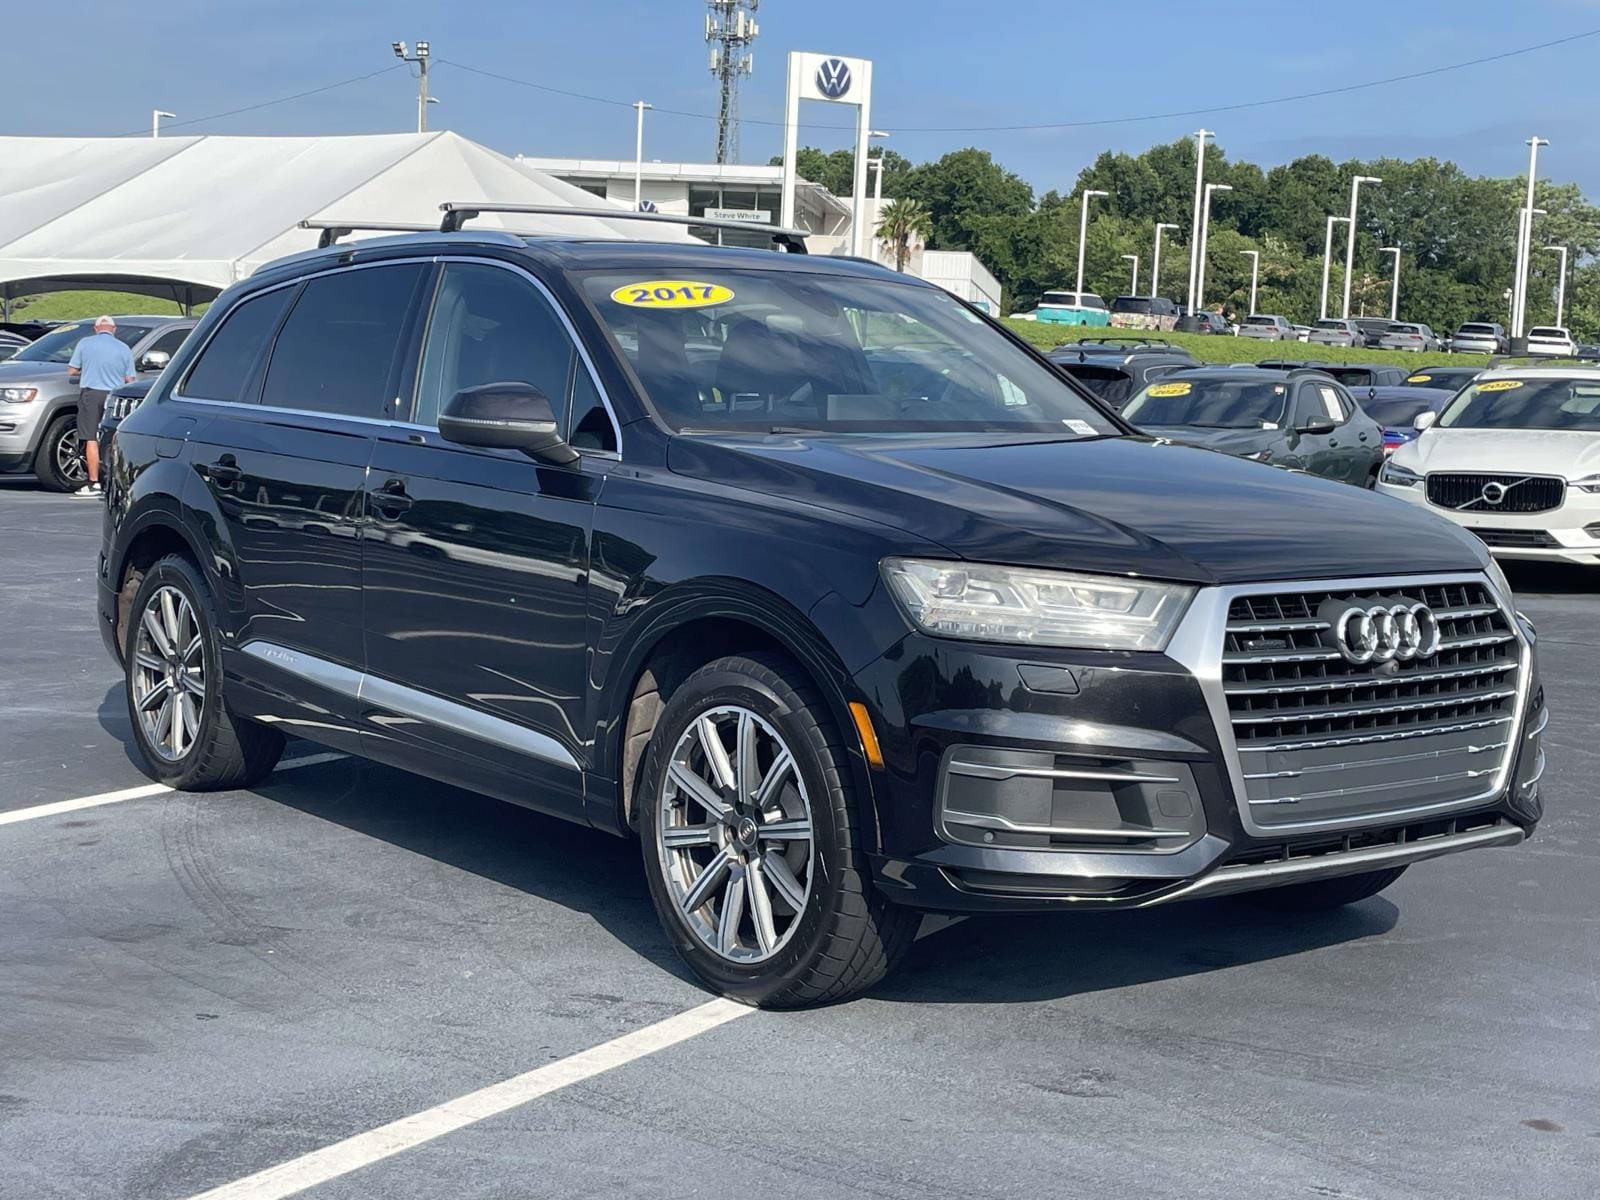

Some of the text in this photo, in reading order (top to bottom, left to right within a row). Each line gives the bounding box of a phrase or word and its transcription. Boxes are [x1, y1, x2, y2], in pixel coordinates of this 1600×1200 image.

[713, 211, 761, 220] Steve White
[629, 286, 714, 302] 2017
